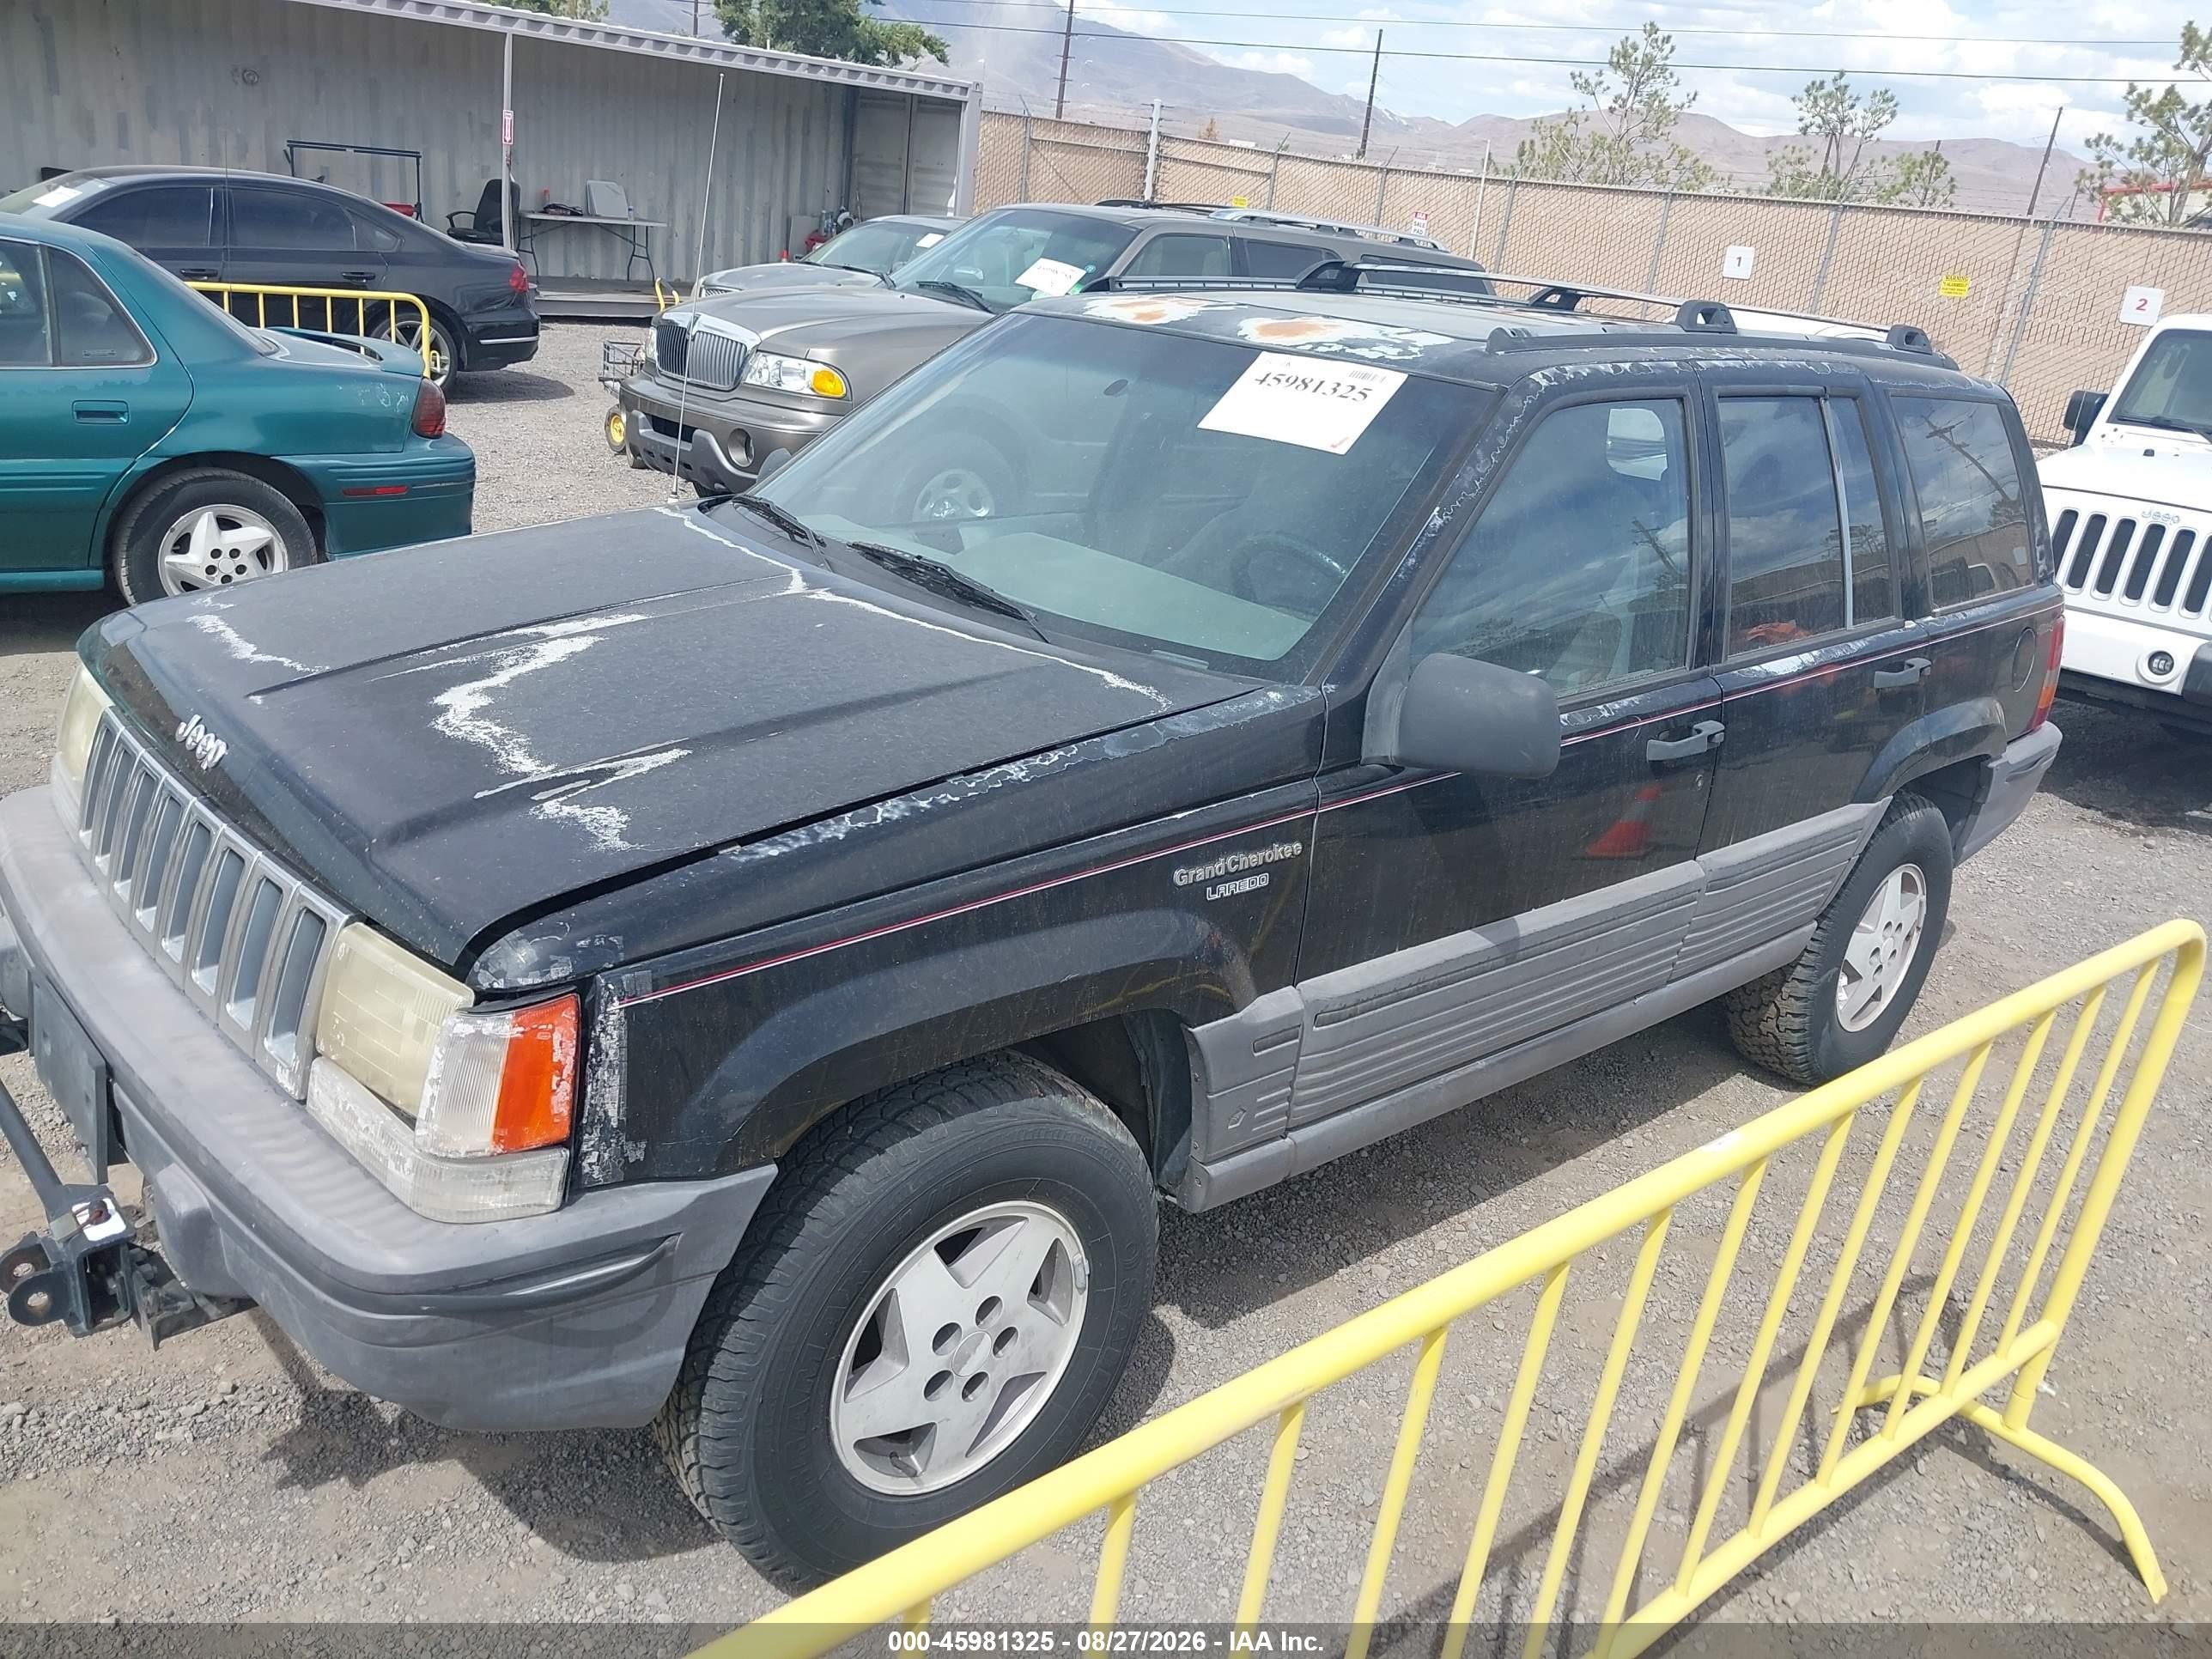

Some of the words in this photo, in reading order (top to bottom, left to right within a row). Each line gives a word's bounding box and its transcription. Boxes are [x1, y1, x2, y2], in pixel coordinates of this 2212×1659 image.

[1736, 256, 1742, 267] 1
[2136, 298, 2148, 311] 2
[1255, 372, 1374, 402] 45981325
[2142, 510, 2180, 526] Jeep
[175, 714, 228, 770] Jeep
[1173, 857, 1225, 886] Grand
[1226, 841, 1303, 873] Cherokee
[1206, 872, 1270, 901] LAREDO
